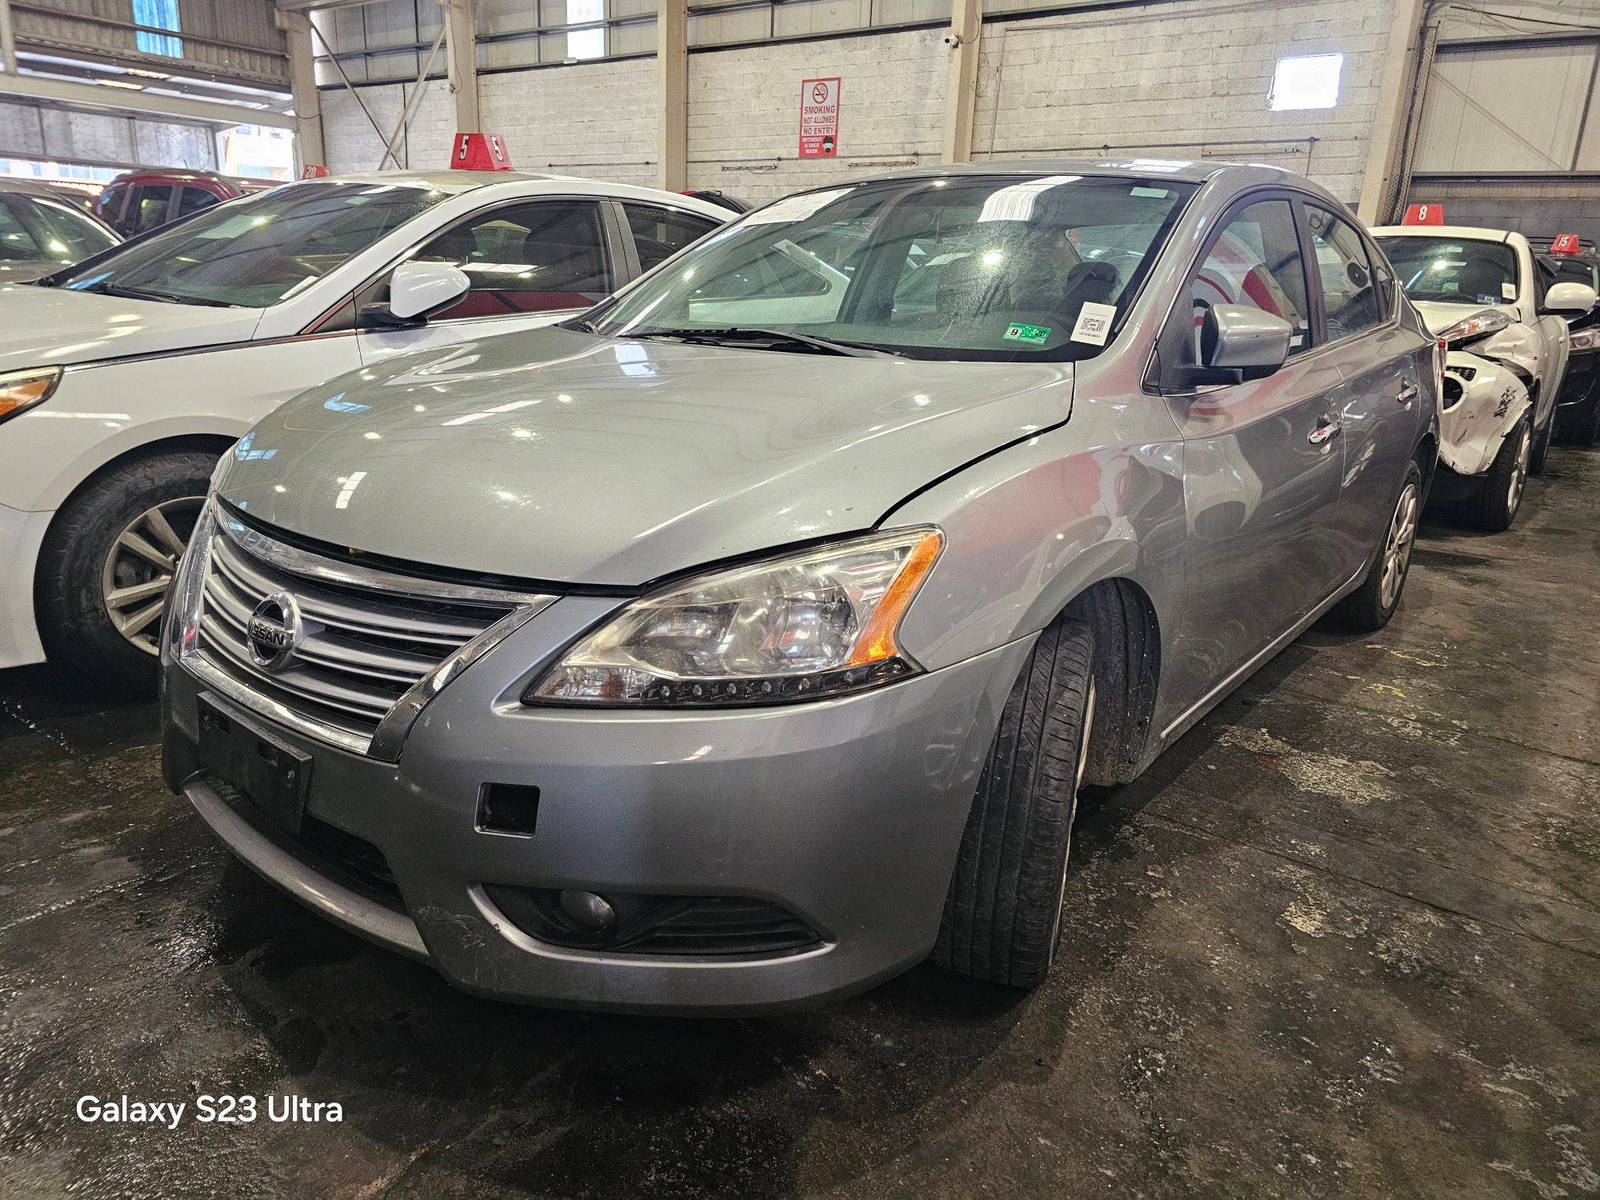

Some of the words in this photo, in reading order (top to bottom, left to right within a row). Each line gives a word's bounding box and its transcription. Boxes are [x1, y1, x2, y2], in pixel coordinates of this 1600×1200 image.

[804, 105, 836, 115] SMOKING
[803, 116, 812, 125] NOT
[813, 115, 835, 124] ALLOWED
[803, 127, 812, 135] NO
[813, 127, 835, 135] ENTRY
[460, 135, 469, 160] 5
[491, 136, 503, 161] 5
[1418, 205, 1428, 221] 8
[1558, 236, 1569, 248] 15
[247, 618, 286, 647] NISSAN
